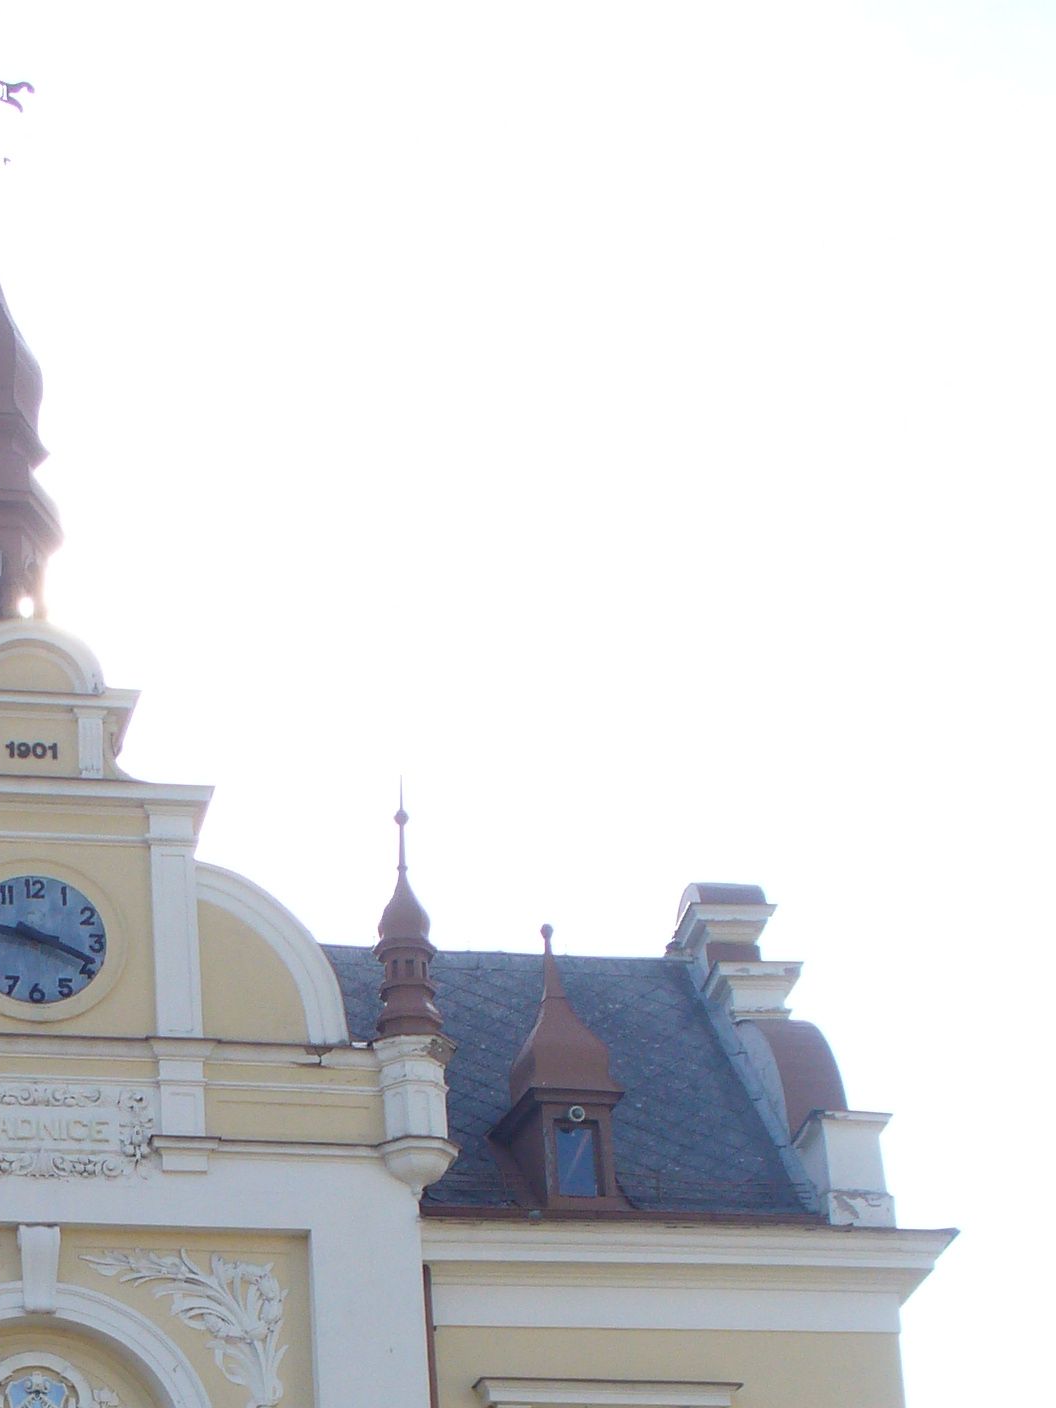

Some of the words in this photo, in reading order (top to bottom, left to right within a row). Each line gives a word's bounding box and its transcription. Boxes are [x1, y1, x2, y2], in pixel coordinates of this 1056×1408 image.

[5, 740, 58, 760] 1901
[0, 885, 14, 905] 11
[24, 879, 45, 899] 12
[60, 886, 68, 906] 1
[79, 907, 96, 926] 2
[88, 934, 105, 954] 3
[5, 975, 21, 996] 7
[29, 983, 46, 1003] 6
[58, 978, 73, 998] 5
